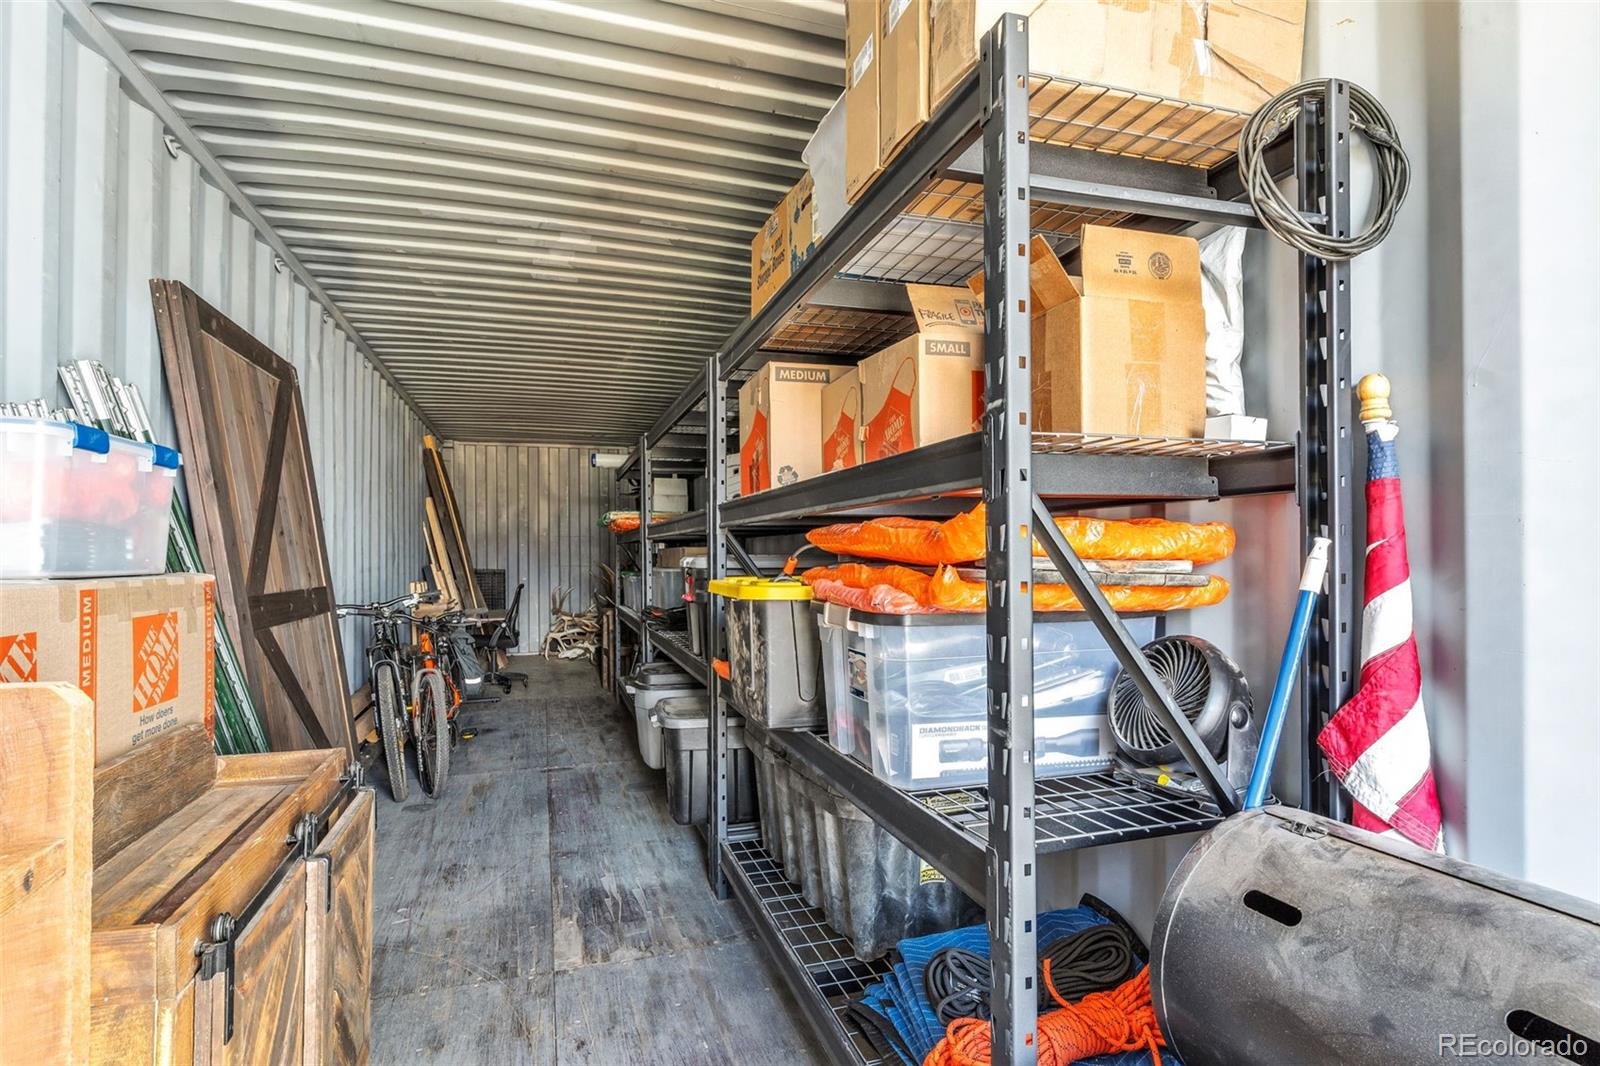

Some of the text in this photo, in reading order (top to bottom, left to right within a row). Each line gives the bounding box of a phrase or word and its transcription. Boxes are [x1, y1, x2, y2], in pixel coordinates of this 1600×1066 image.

[918, 307, 955, 320] FRAGILE
[930, 342, 966, 354] SMALL
[779, 369, 826, 381] MEDIUM
[82, 597, 92, 687] MEDIUM
[139, 624, 157, 663] THE
[133, 612, 178, 709] HOME
[152, 642, 178, 704] DEPOT
[139, 706, 174, 726] How doers
[131, 717, 178, 745] get more done
